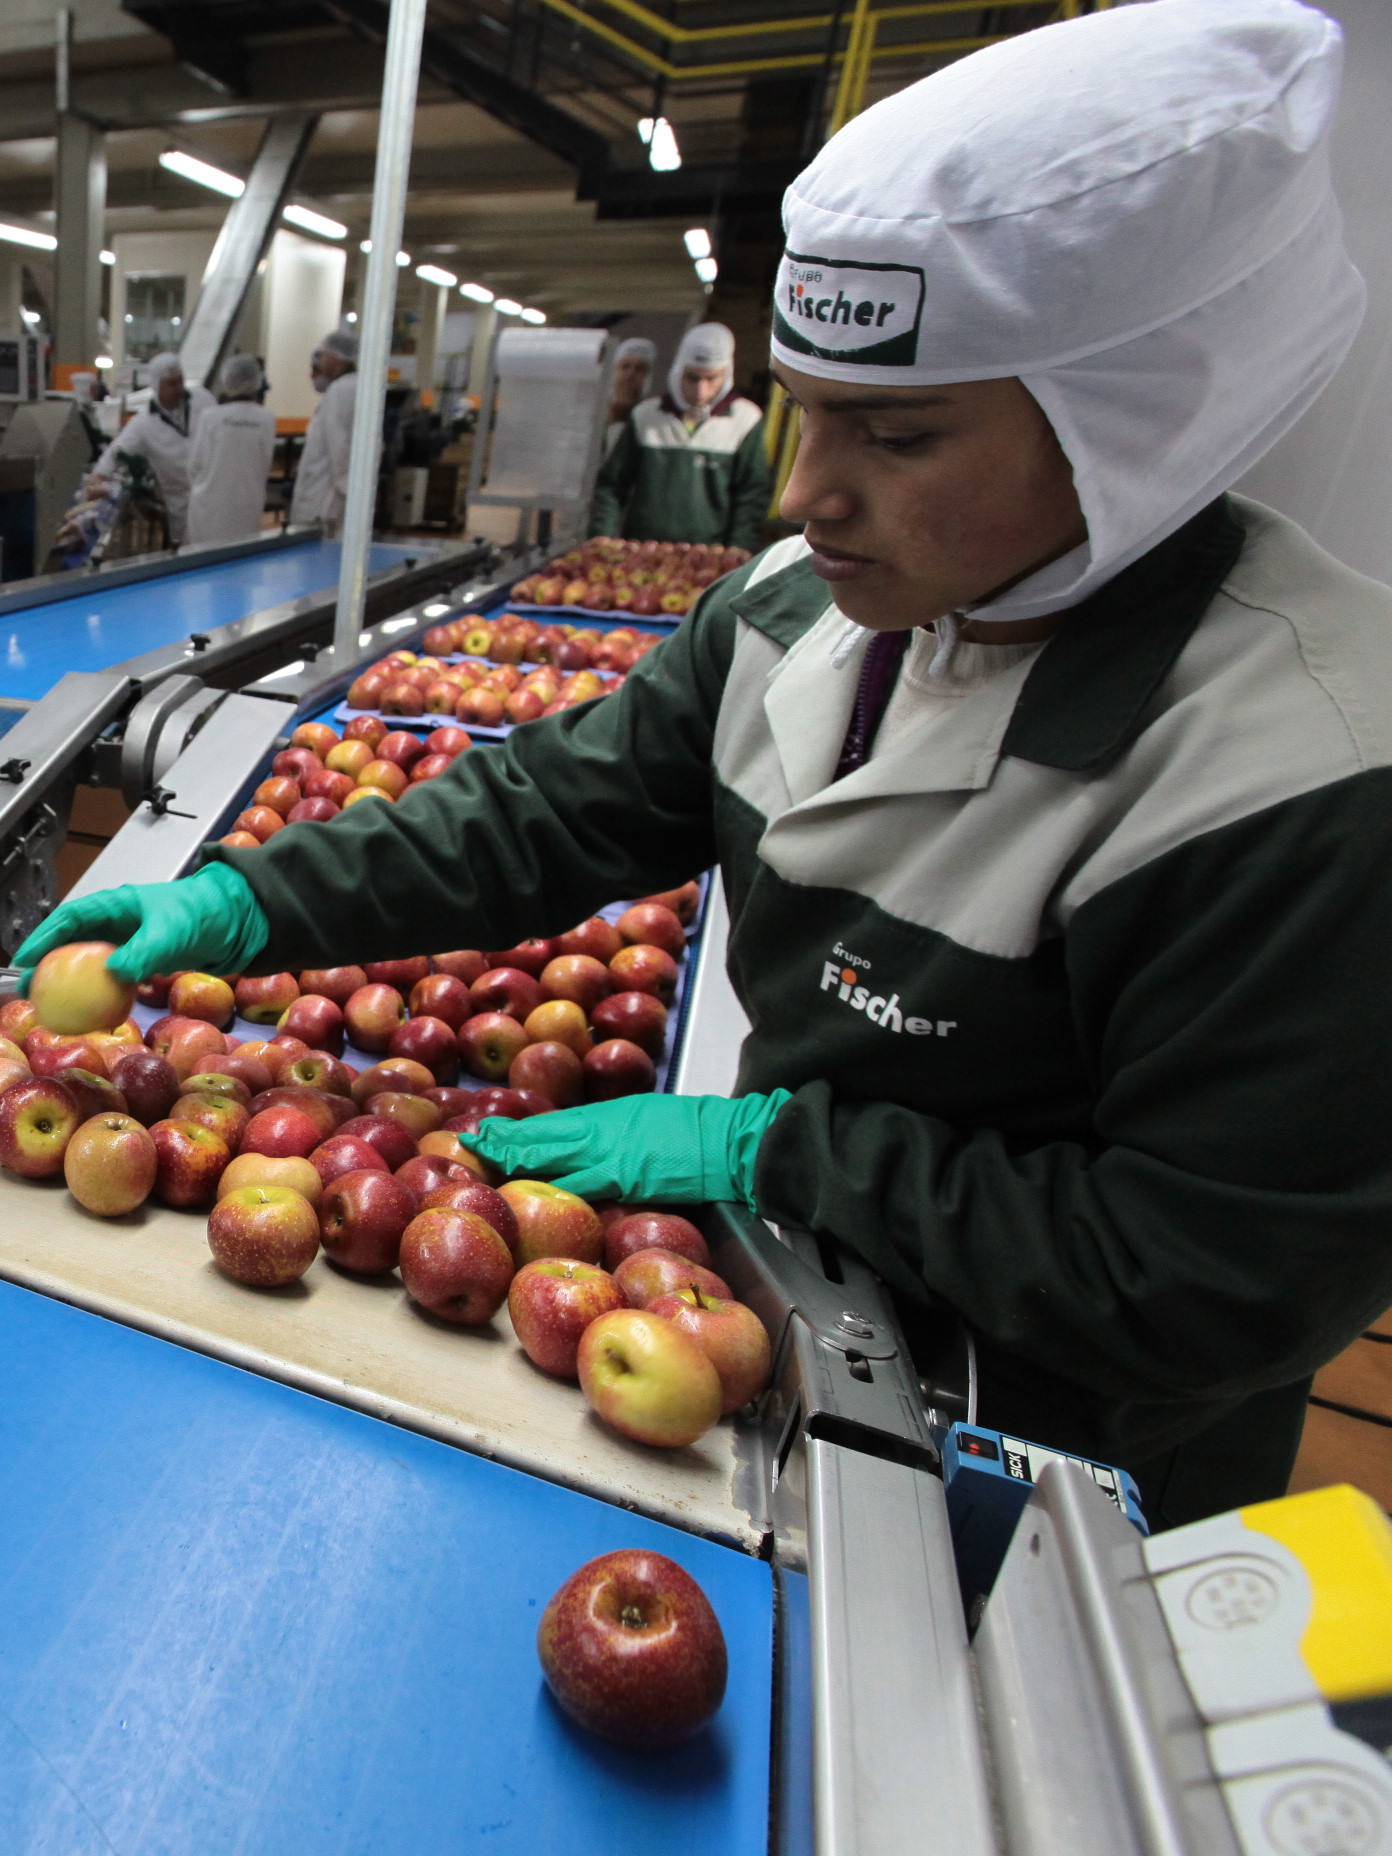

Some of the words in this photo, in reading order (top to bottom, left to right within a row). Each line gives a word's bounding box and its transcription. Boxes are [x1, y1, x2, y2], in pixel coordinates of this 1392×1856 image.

[789, 283, 895, 327] Fischer
[832, 941, 872, 970] Grupo
[819, 960, 958, 1038] Fischer
[1010, 1452, 1025, 1479] SICK
